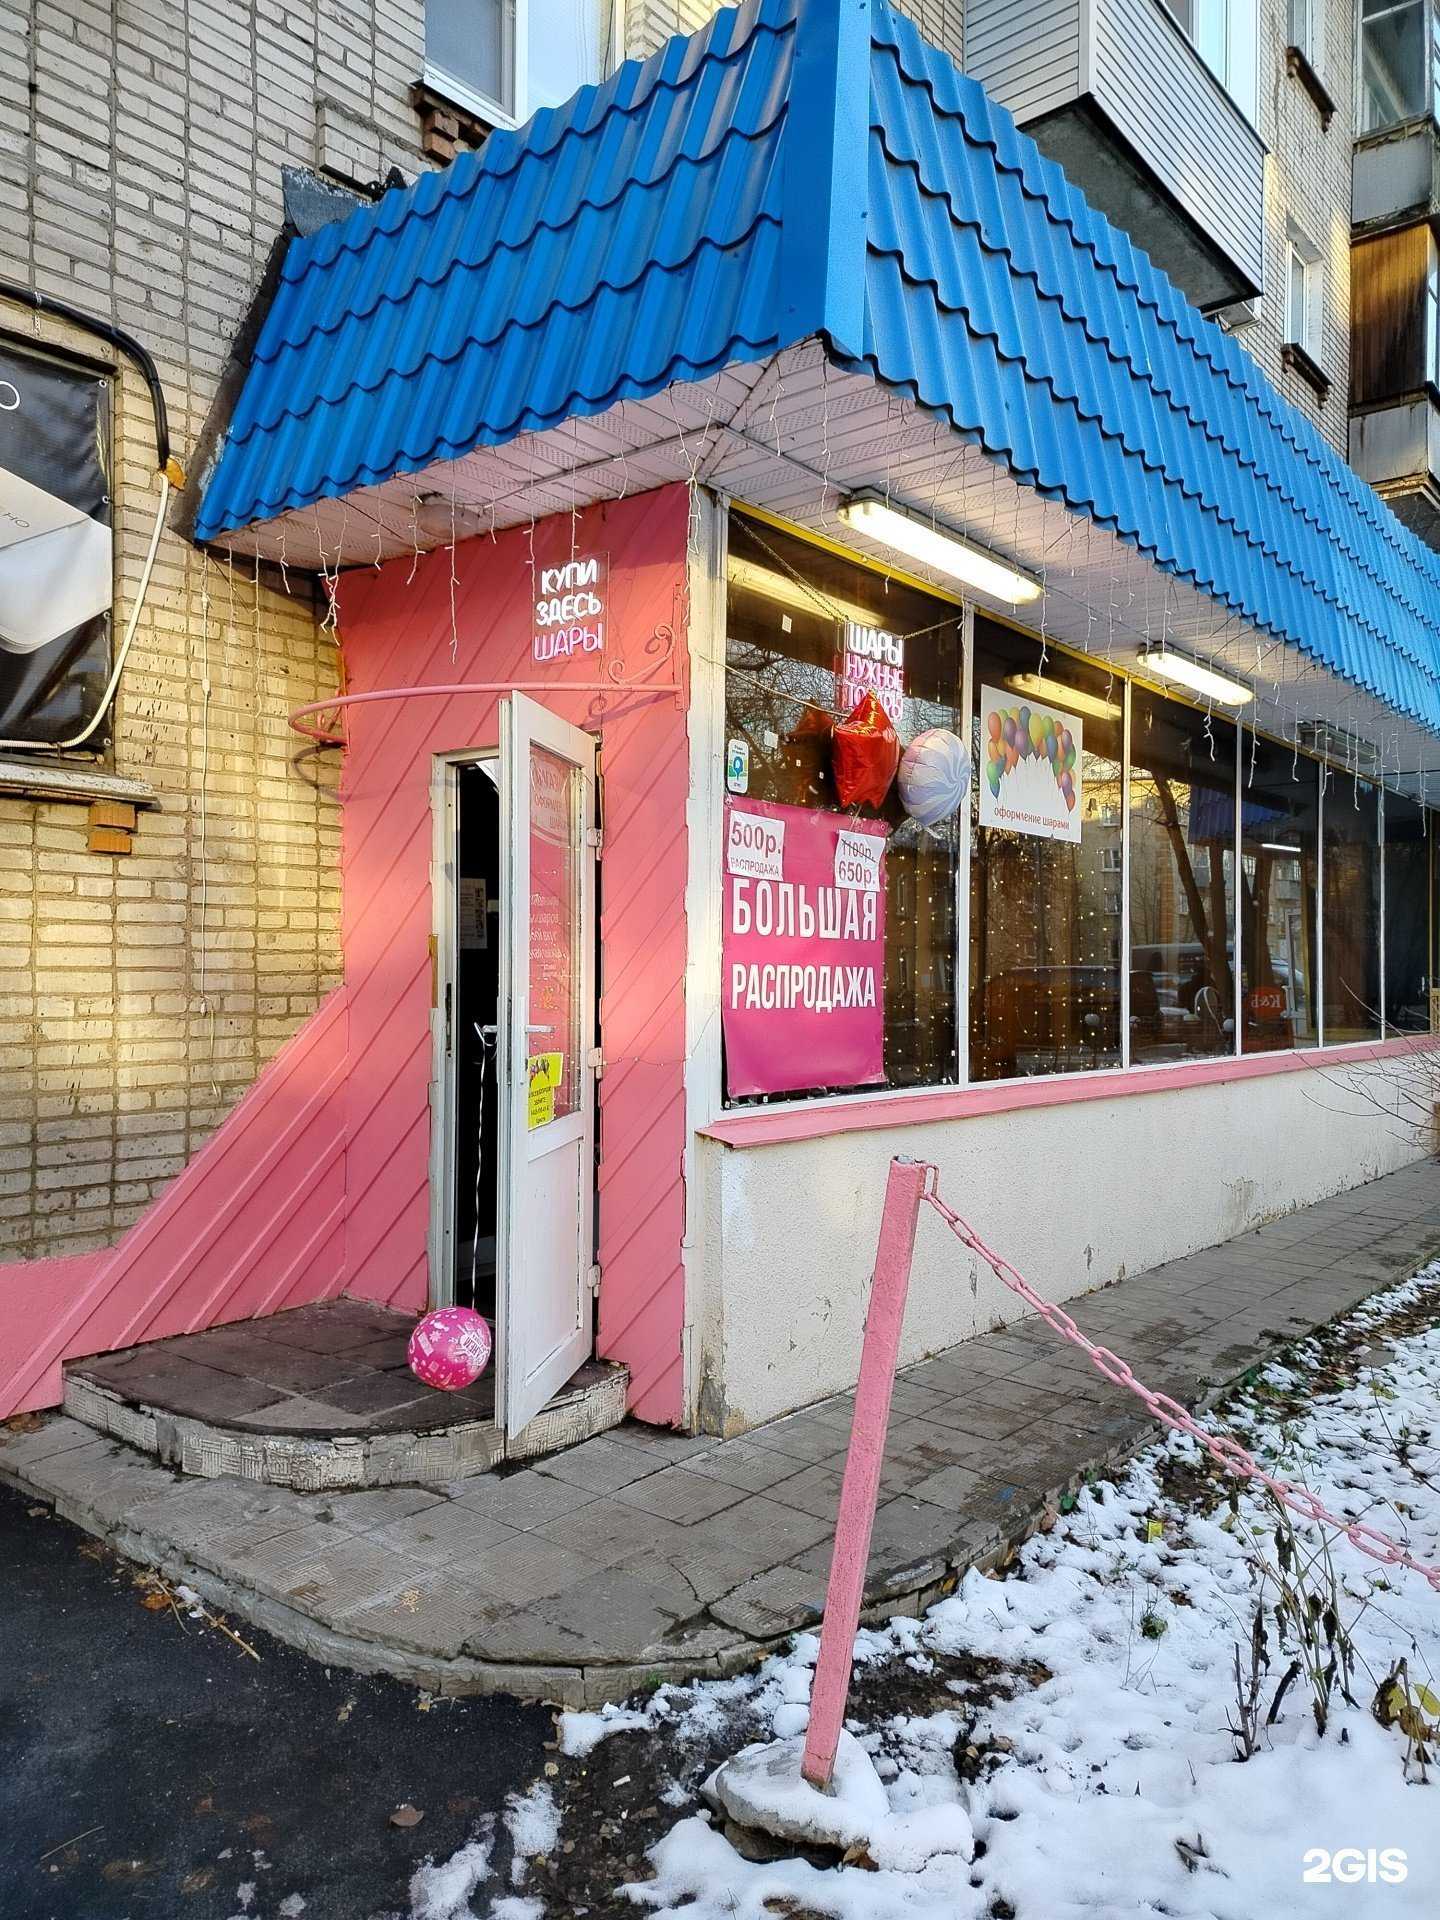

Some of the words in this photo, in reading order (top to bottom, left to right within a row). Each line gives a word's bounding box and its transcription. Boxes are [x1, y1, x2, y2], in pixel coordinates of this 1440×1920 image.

[541, 558, 598, 594] КУПИ
[536, 592, 602, 626] ЗДЕСЬ
[534, 623, 603, 660] ШАРЫ
[847, 621, 903, 667] ШАРЫ
[846, 653, 904, 691] НУЖНЫЕ
[994, 805, 1040, 824] оформление
[1042, 816, 1070, 830] шарами
[731, 820, 781, 858] 500р.
[730, 857, 780, 876] РАСПРОДАЖА
[839, 861, 875, 889] 650р.
[732, 877, 876, 941] БОЛЬШАЯ
[731, 963, 876, 1013] РАСПРОДАЖА
